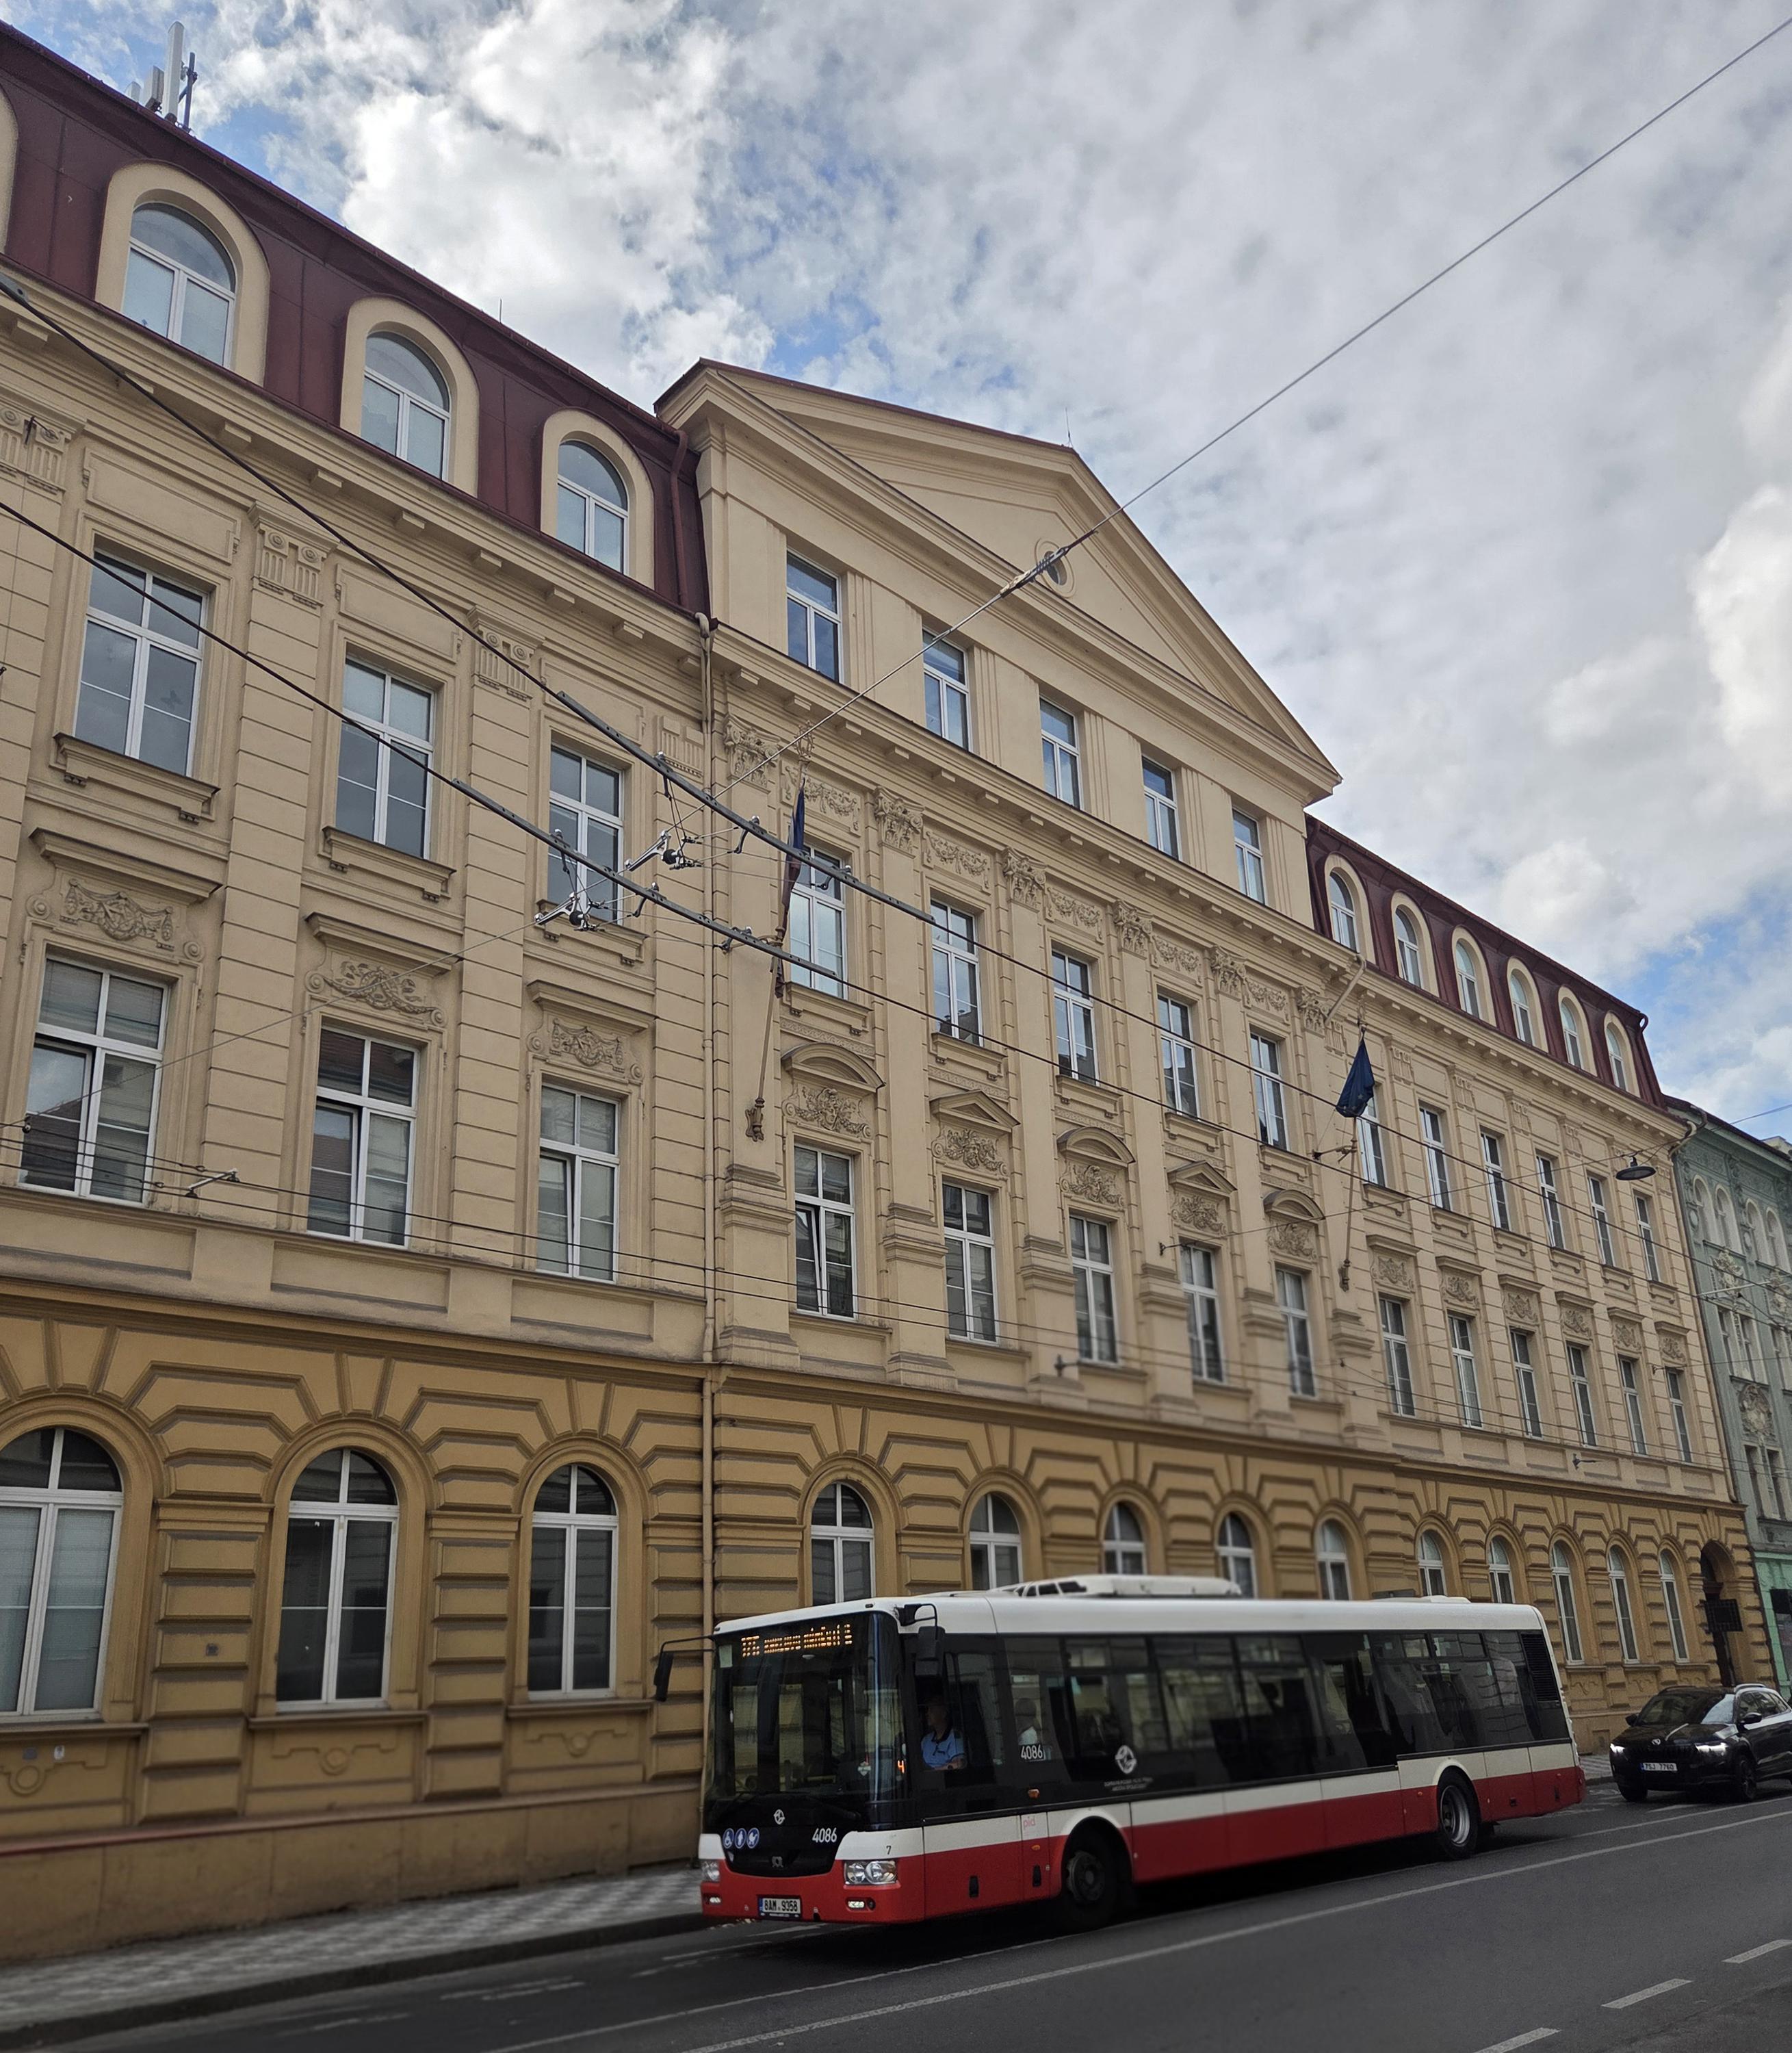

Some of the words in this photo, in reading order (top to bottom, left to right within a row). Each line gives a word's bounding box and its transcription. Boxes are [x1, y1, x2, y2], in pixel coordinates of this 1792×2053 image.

[1021, 1744, 1043, 1759] 4086
[812, 1827, 837, 1843] 4086
[886, 1845, 892, 1855] 7
[764, 1900, 777, 1911] 8AM
